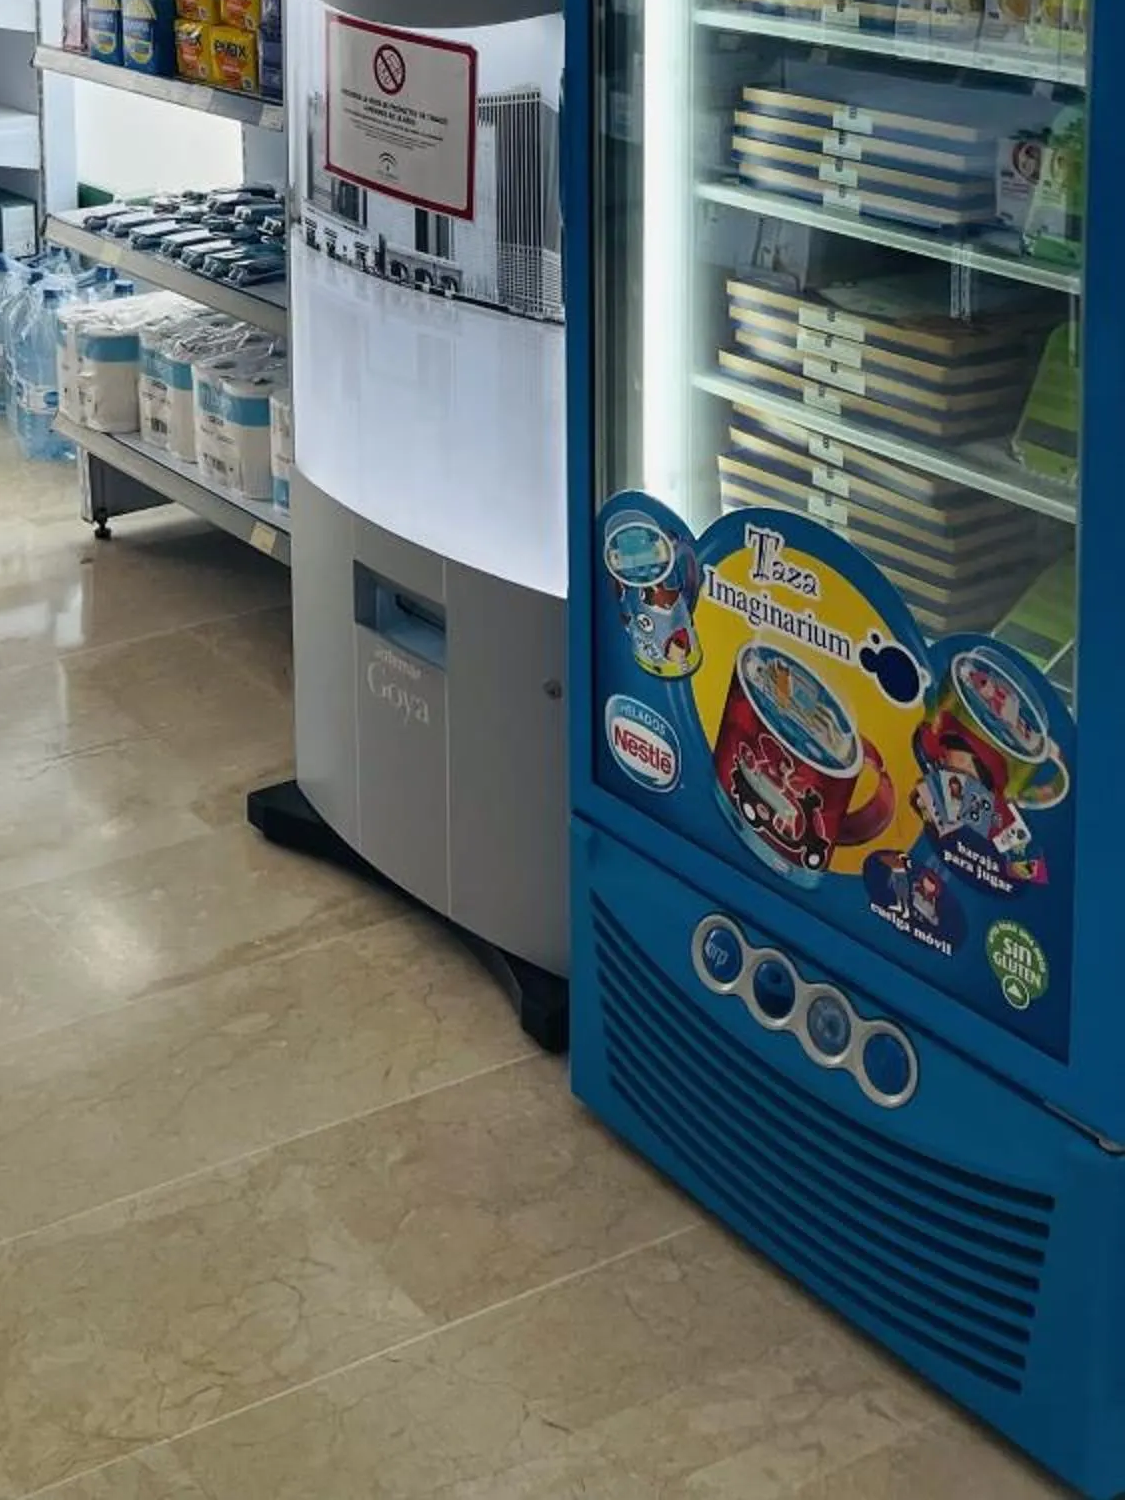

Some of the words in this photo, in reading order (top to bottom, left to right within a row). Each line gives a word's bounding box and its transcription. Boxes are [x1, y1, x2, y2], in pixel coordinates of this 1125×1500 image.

[747, 527, 818, 597] Taza
[707, 569, 851, 661] Imaginarium
[614, 723, 672, 775] Nestlé
[943, 849, 975, 873] para
[976, 865, 1015, 894] jugar
[913, 927, 953, 957] móvil
[991, 951, 1043, 991] GLUTEN
